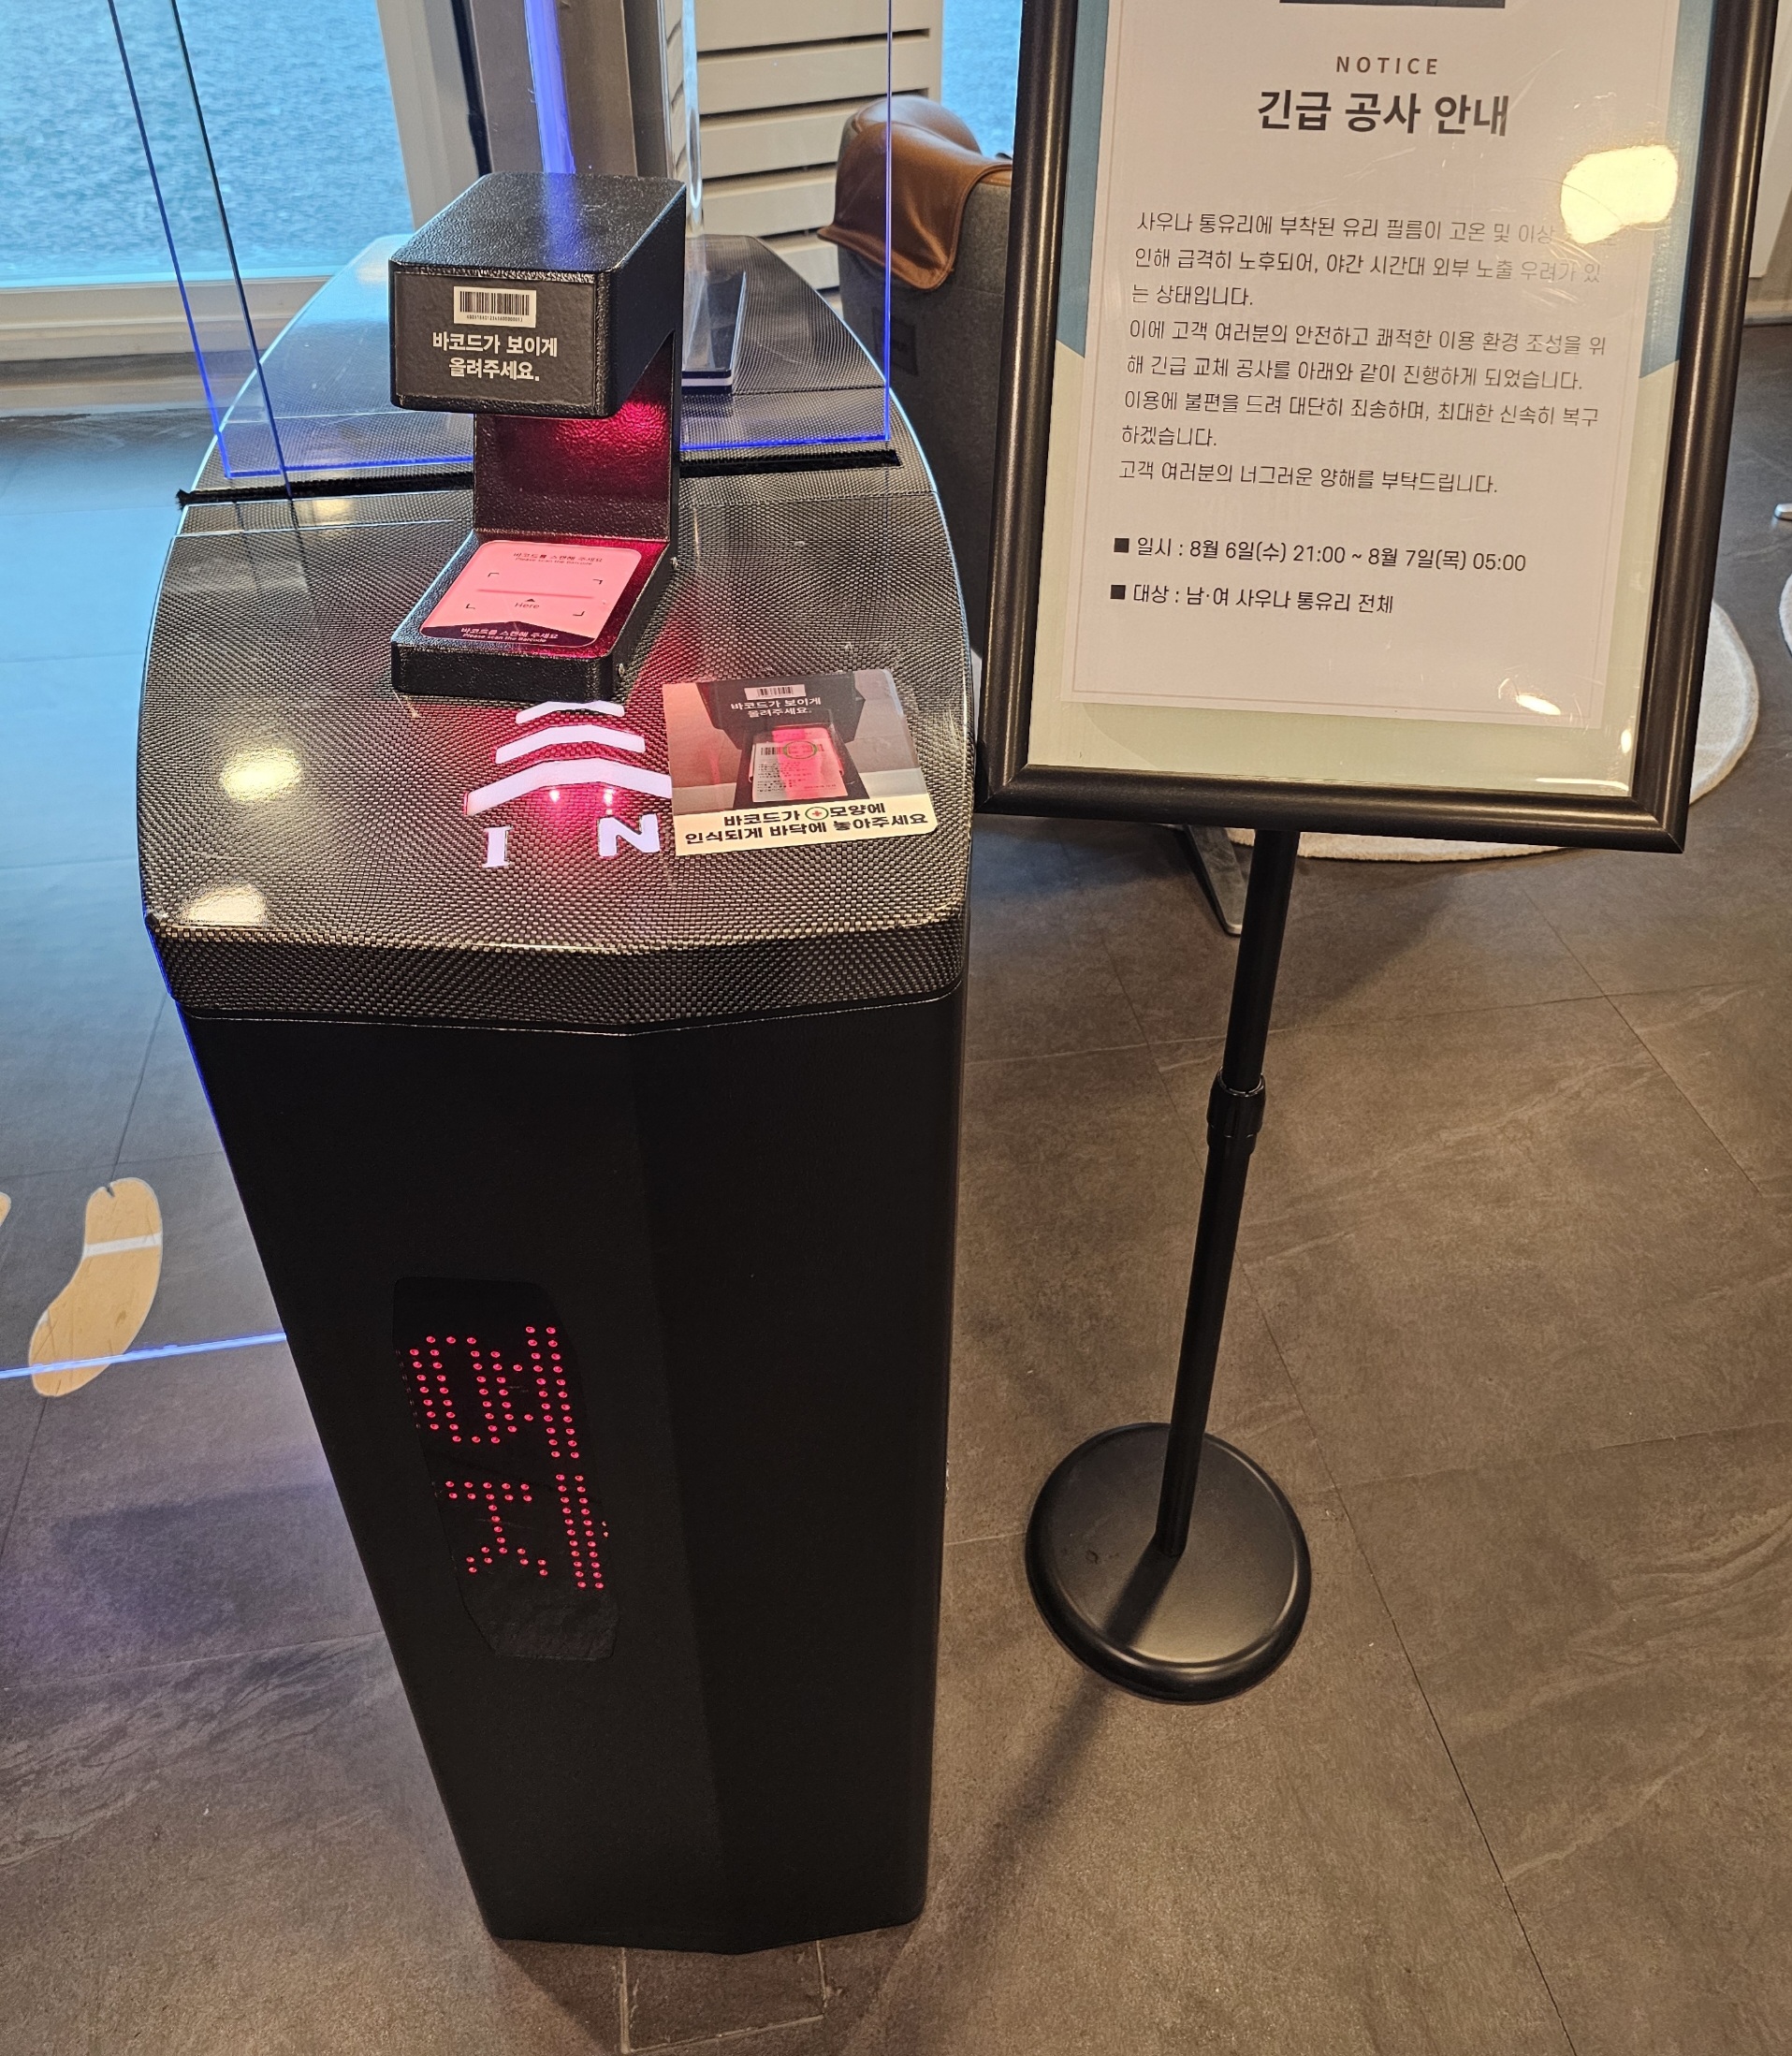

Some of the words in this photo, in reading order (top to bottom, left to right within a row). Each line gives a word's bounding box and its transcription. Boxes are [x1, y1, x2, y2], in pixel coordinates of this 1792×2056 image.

[1335, 54, 1440, 76] NOTICE
[1256, 89, 1332, 131] 긴급
[1345, 92, 1421, 134] 공사
[1434, 94, 1509, 137] 안내
[1136, 211, 1193, 232] 사우나
[1199, 213, 1274, 235] 통유리에
[1279, 216, 1335, 237] 부착된
[1343, 217, 1378, 238] 유리
[1386, 218, 1442, 241] 필름이
[1449, 221, 1486, 241] 고온
[1493, 223, 1510, 243] 및
[1518, 224, 1557, 245] 이상
[1135, 248, 1171, 269] 인해
[1177, 249, 1232, 270] 급격히
[1238, 251, 1319, 273] 노후되어,
[1326, 254, 1363, 274] 야간
[1369, 255, 1426, 276] 시간대
[1432, 256, 1470, 278] 외부
[1476, 258, 1514, 280] 노출
[1520, 260, 1578, 283] 우려가
[1131, 284, 1149, 303] 는
[1156, 284, 1254, 306] 상태입니다.
[432, 331, 501, 355] 바코드가
[506, 334, 558, 357] 보이게
[1129, 319, 1165, 340] 이에
[1172, 321, 1208, 341] 고객
[1215, 322, 1288, 343] 여러분의
[1295, 325, 1368, 346] 안전하고
[1376, 328, 1433, 349] 쾌적한
[1438, 329, 1476, 351] 이용
[1482, 331, 1519, 353] 환경
[1525, 333, 1581, 356] 조성을
[1588, 336, 1607, 357] 위
[448, 357, 541, 382] 올려주세요.
[1127, 354, 1144, 374] 해
[1151, 356, 1187, 375] 긴급
[1193, 357, 1230, 377] 교체
[1236, 358, 1291, 380] 공사를
[1298, 360, 1354, 382] 아래와
[1359, 362, 1396, 384] 같이
[1403, 364, 1477, 386] 진행하게
[1484, 367, 1583, 390] 되었습니다.
[1125, 390, 1178, 411] 이용에
[1185, 392, 1239, 413] 불편을
[1246, 394, 1282, 415] 드려
[1289, 396, 1344, 417] 대단히
[1350, 398, 1430, 422] 죄송하며,
[1437, 401, 1494, 423] 최대한
[1499, 404, 1555, 426] 신속히
[1562, 406, 1599, 427] 복구
[1122, 424, 1217, 447] 하겠습니다.
[1118, 460, 1155, 480] 고객
[1160, 461, 1233, 483] 여러분의
[1240, 465, 1314, 487] 너그러운
[1319, 468, 1375, 489] 양해를
[1381, 470, 1498, 494] 부탁드립니다.
[1136, 536, 1173, 557] 일시
[1189, 539, 1218, 559] 8월
[1225, 540, 1287, 562] 6일(수)
[1292, 545, 1346, 563] 21:00
[1367, 547, 1398, 567] 8월
[1405, 548, 1467, 570] 7일(목)
[1472, 552, 1527, 572] 05:00
[1132, 583, 1170, 604] 대상
[1235, 589, 1291, 609] 사우나
[1296, 591, 1351, 613] 통유리
[1357, 593, 1394, 614] 전체
[730, 699, 782, 711] 바코드가
[784, 695, 822, 707] 보이게
[684, 826, 764, 846] 인식되게
[769, 821, 827, 838] 바닥에
[832, 812, 929, 831] 놓아주세요
[723, 809, 801, 827] 바코드가
[829, 802, 887, 818] 모양에
